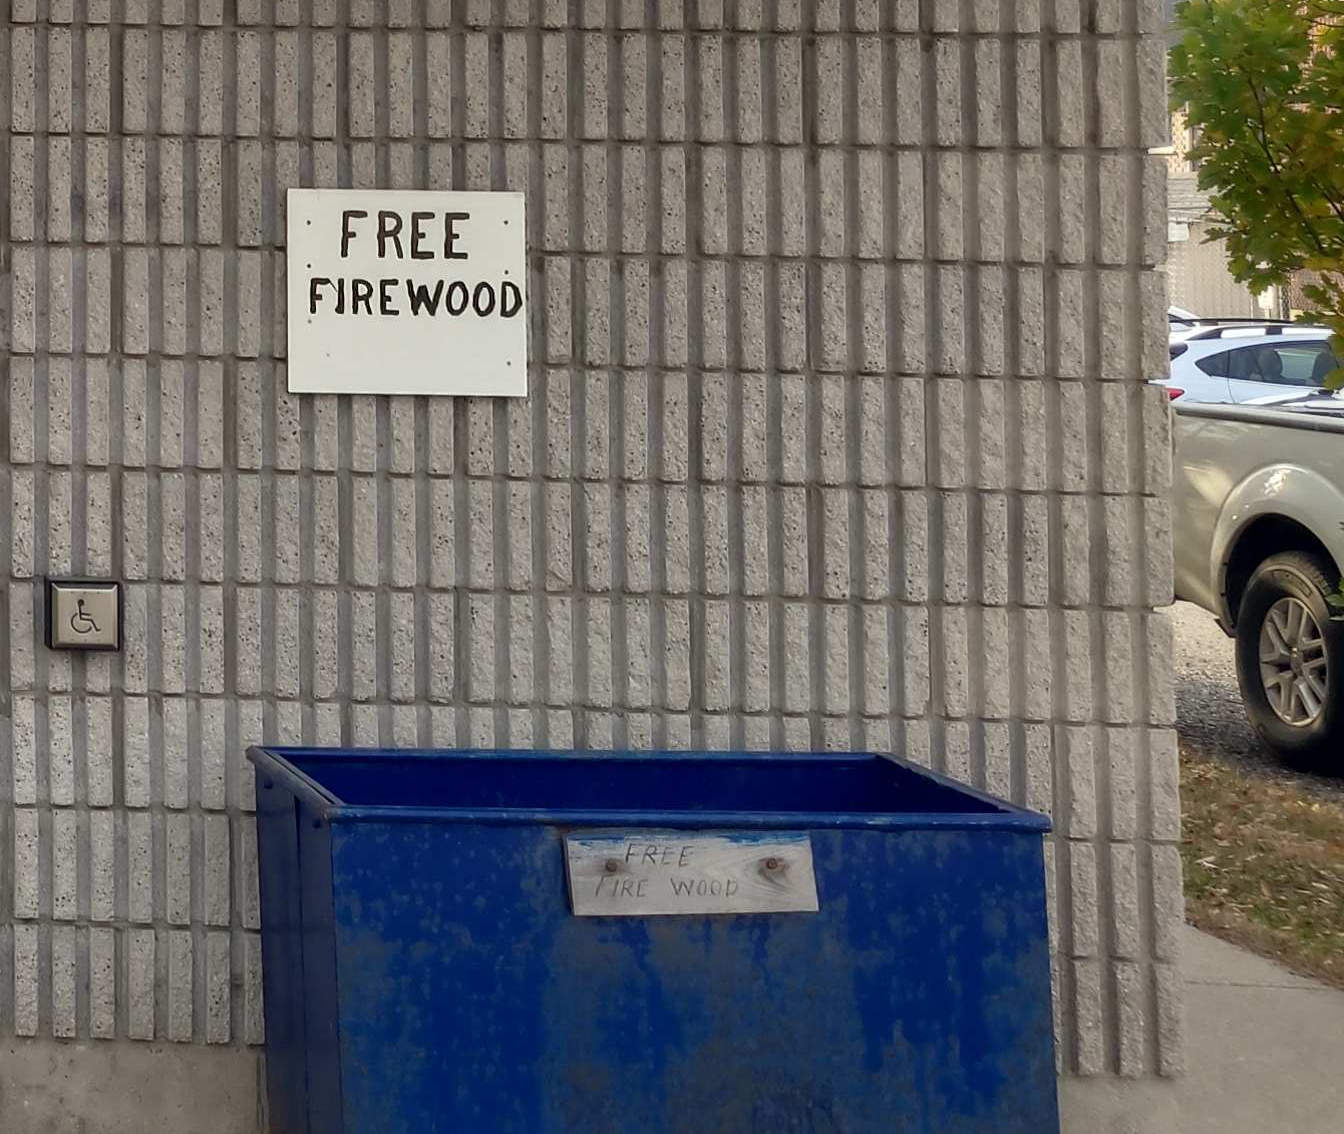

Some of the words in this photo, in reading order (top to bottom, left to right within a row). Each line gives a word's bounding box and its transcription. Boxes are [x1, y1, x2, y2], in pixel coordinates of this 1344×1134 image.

[341, 210, 470, 260] FREE
[309, 278, 523, 318] FIREWOOD
[625, 843, 694, 867] FREE
[595, 874, 648, 898] FIRE
[670, 876, 739, 897] WOOD
